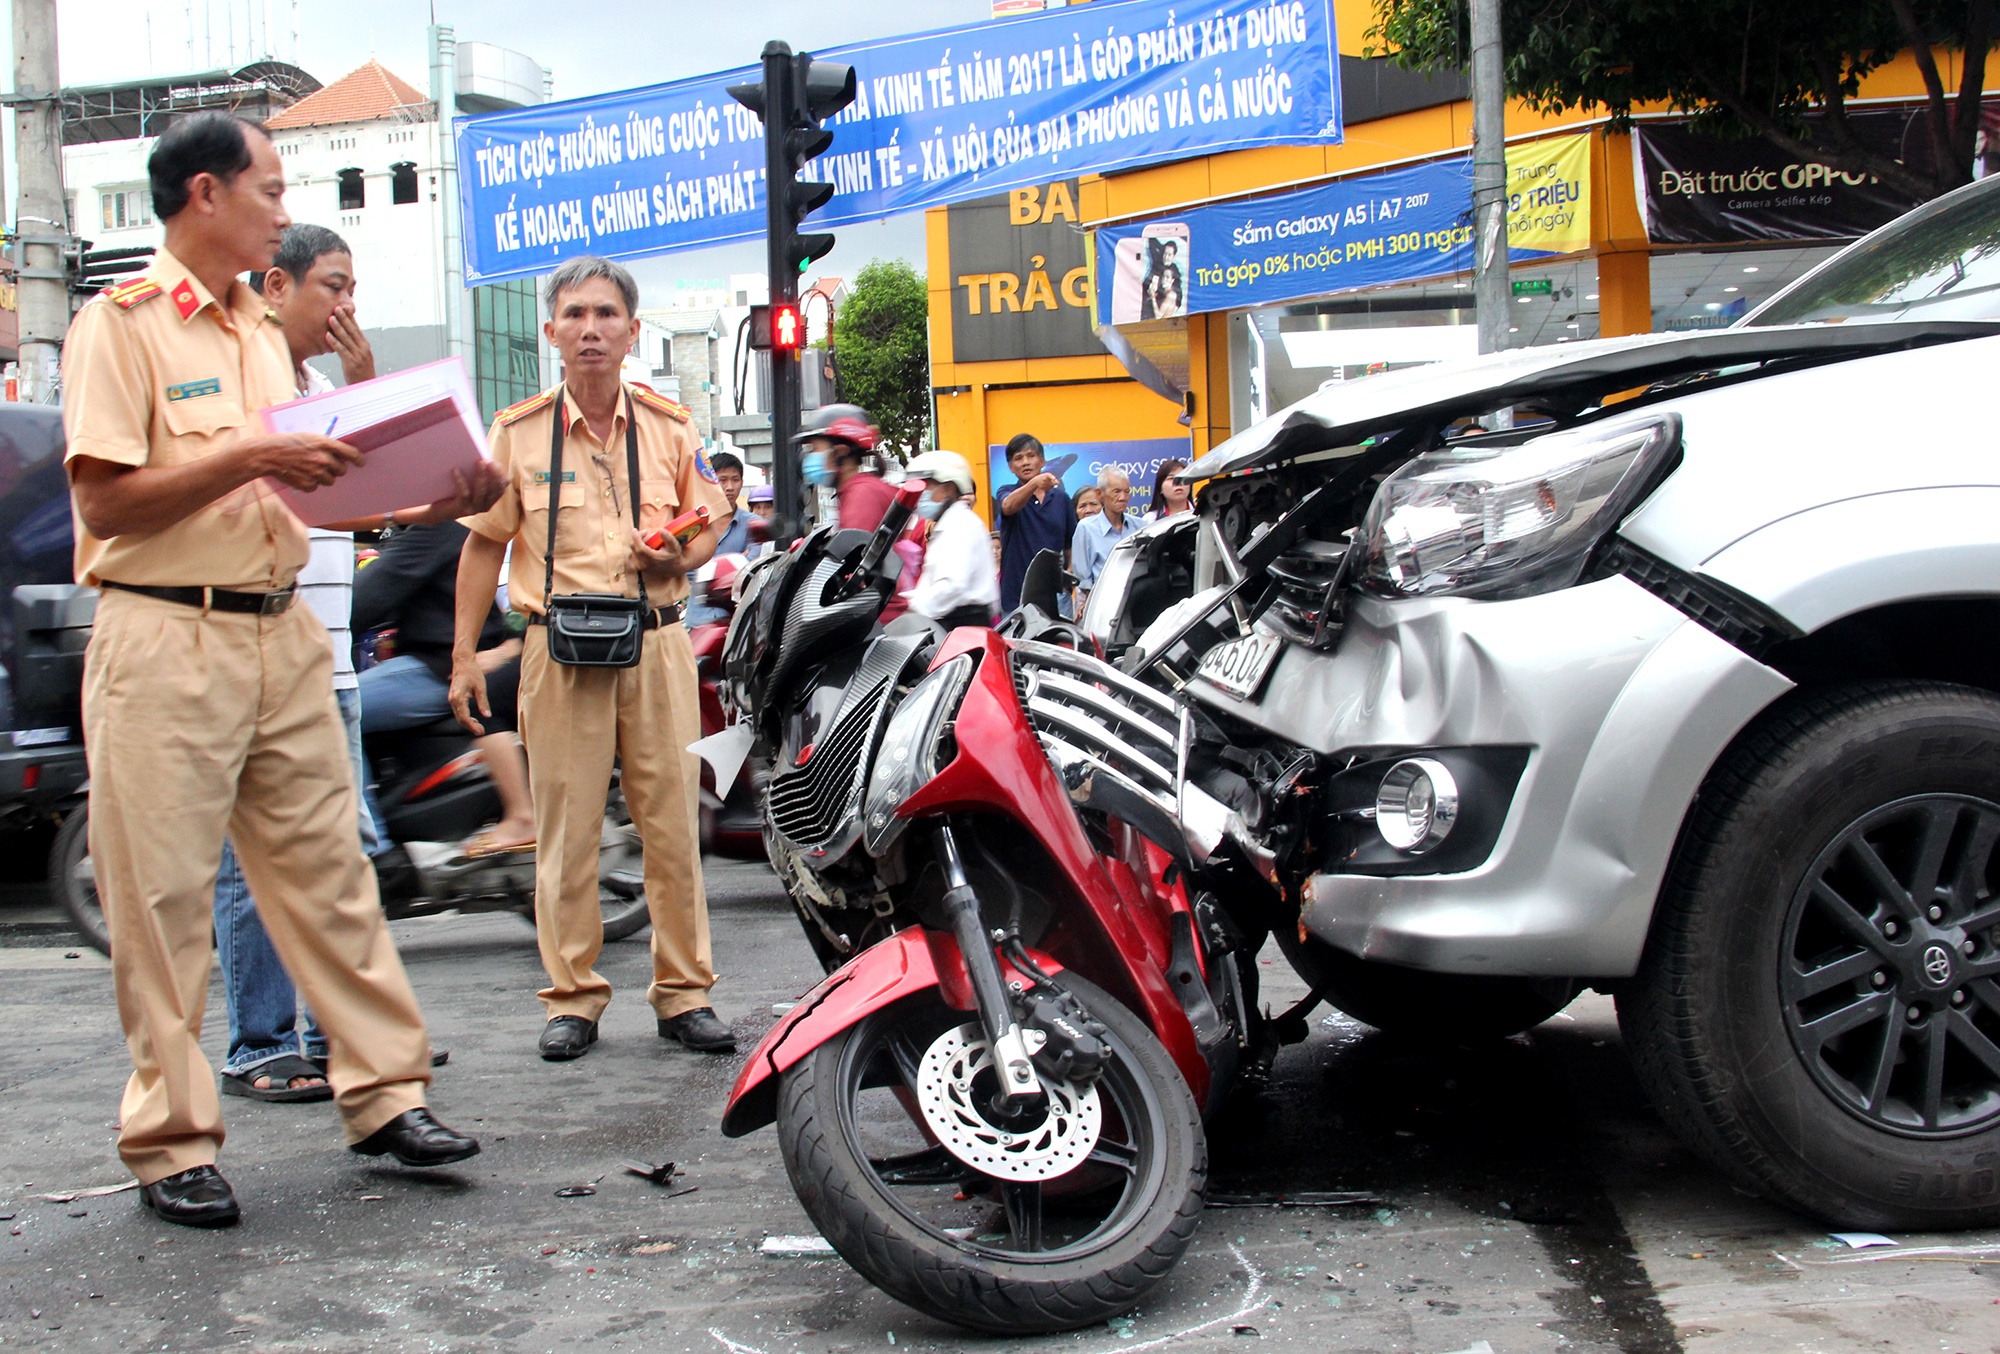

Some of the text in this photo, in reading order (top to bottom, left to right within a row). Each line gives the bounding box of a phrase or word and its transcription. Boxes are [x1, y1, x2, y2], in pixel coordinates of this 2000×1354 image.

[476, 137, 517, 188] TÍCH
[520, 130, 556, 189] CỰC
[560, 115, 622, 173] HƯỞNG
[625, 110, 665, 161] ỨNG
[668, 100, 720, 160] CUỘC
[873, 71, 924, 118] KINH
[926, 48, 955, 109] TẾ
[958, 50, 1004, 104] NĂM
[1008, 49, 1053, 96] 2017
[1059, 32, 1087, 87] LÀ
[1091, 26, 1133, 82] GÓP
[1137, 9, 1194, 73] PHẦN
[1199, 9, 1241, 59] XÂY
[1246, 1, 1307, 58] DỰNG
[494, 193, 520, 253] KẾ
[522, 199, 590, 255] HOẠCH,
[591, 181, 651, 236] CHÍNH
[652, 172, 704, 226] SÁCH
[706, 160, 756, 217] PHÁT
[823, 151, 873, 196] KINH
[876, 127, 903, 188] TẾ
[920, 126, 949, 182] XÃ
[952, 122, 988, 182] HỘI
[992, 110, 1031, 167] CỦA
[1037, 111, 1071, 164] ĐỊA
[1076, 94, 1160, 147] PHƯƠNG
[1164, 77, 1194, 129] VÀ
[1198, 67, 1228, 124] CẢ
[1232, 63, 1293, 120] NƯỚC
[1516, 162, 1558, 180] Trúng
[1527, 178, 1579, 210] TRIỆU
[1659, 170, 1705, 199] Đặt
[1708, 165, 1778, 194] trước
[1233, 219, 1273, 246] Sắm
[1275, 212, 1340, 239] Galaxy
[1343, 204, 1367, 227] A5
[1378, 198, 1402, 221] A7
[1405, 192, 1430, 209] 2017
[1728, 194, 1832, 210] Camera Selfie Kép
[1535, 210, 1575, 232] ngày
[1196, 263, 1223, 287] Trả
[1226, 258, 1261, 288] góp
[1264, 253, 1290, 275] 0%
[1293, 245, 1343, 272] hoặc
[1346, 237, 1384, 263] PMH
[1387, 231, 1421, 255] 300
[958, 254, 1059, 315] TRẢ
[1664, 316, 1729, 328] SAMSUNG
